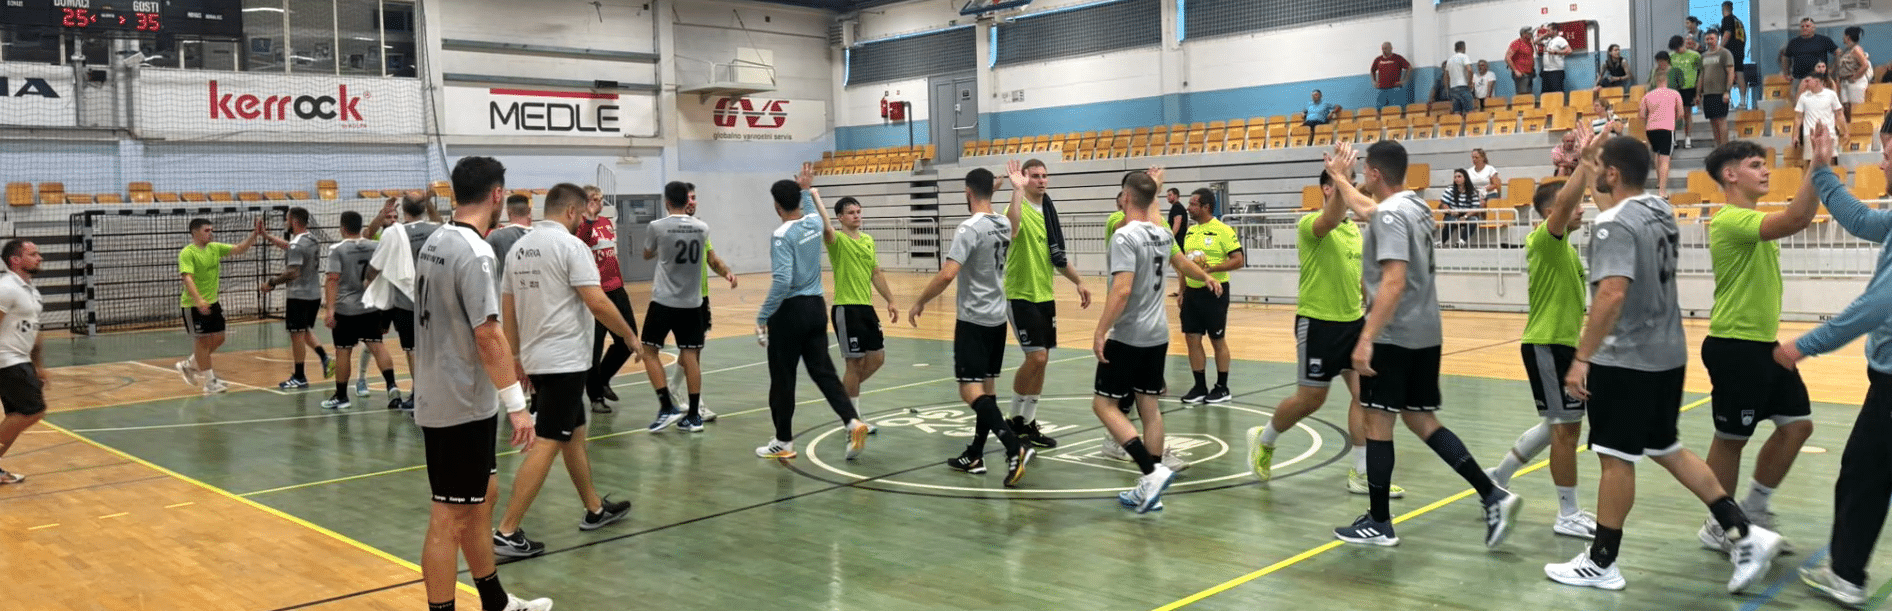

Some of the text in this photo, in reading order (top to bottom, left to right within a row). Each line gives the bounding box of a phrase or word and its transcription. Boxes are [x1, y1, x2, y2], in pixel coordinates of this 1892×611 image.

[63, 8, 89, 28] 25
[133, 1, 159, 13] GOSTI
[135, 12, 161, 32] 35
[208, 80, 364, 122] kerrock
[490, 101, 621, 133] MEDLE
[713, 132, 741, 140] globalno
[675, 239, 701, 265] 20
[1153, 255, 1164, 292] 3
